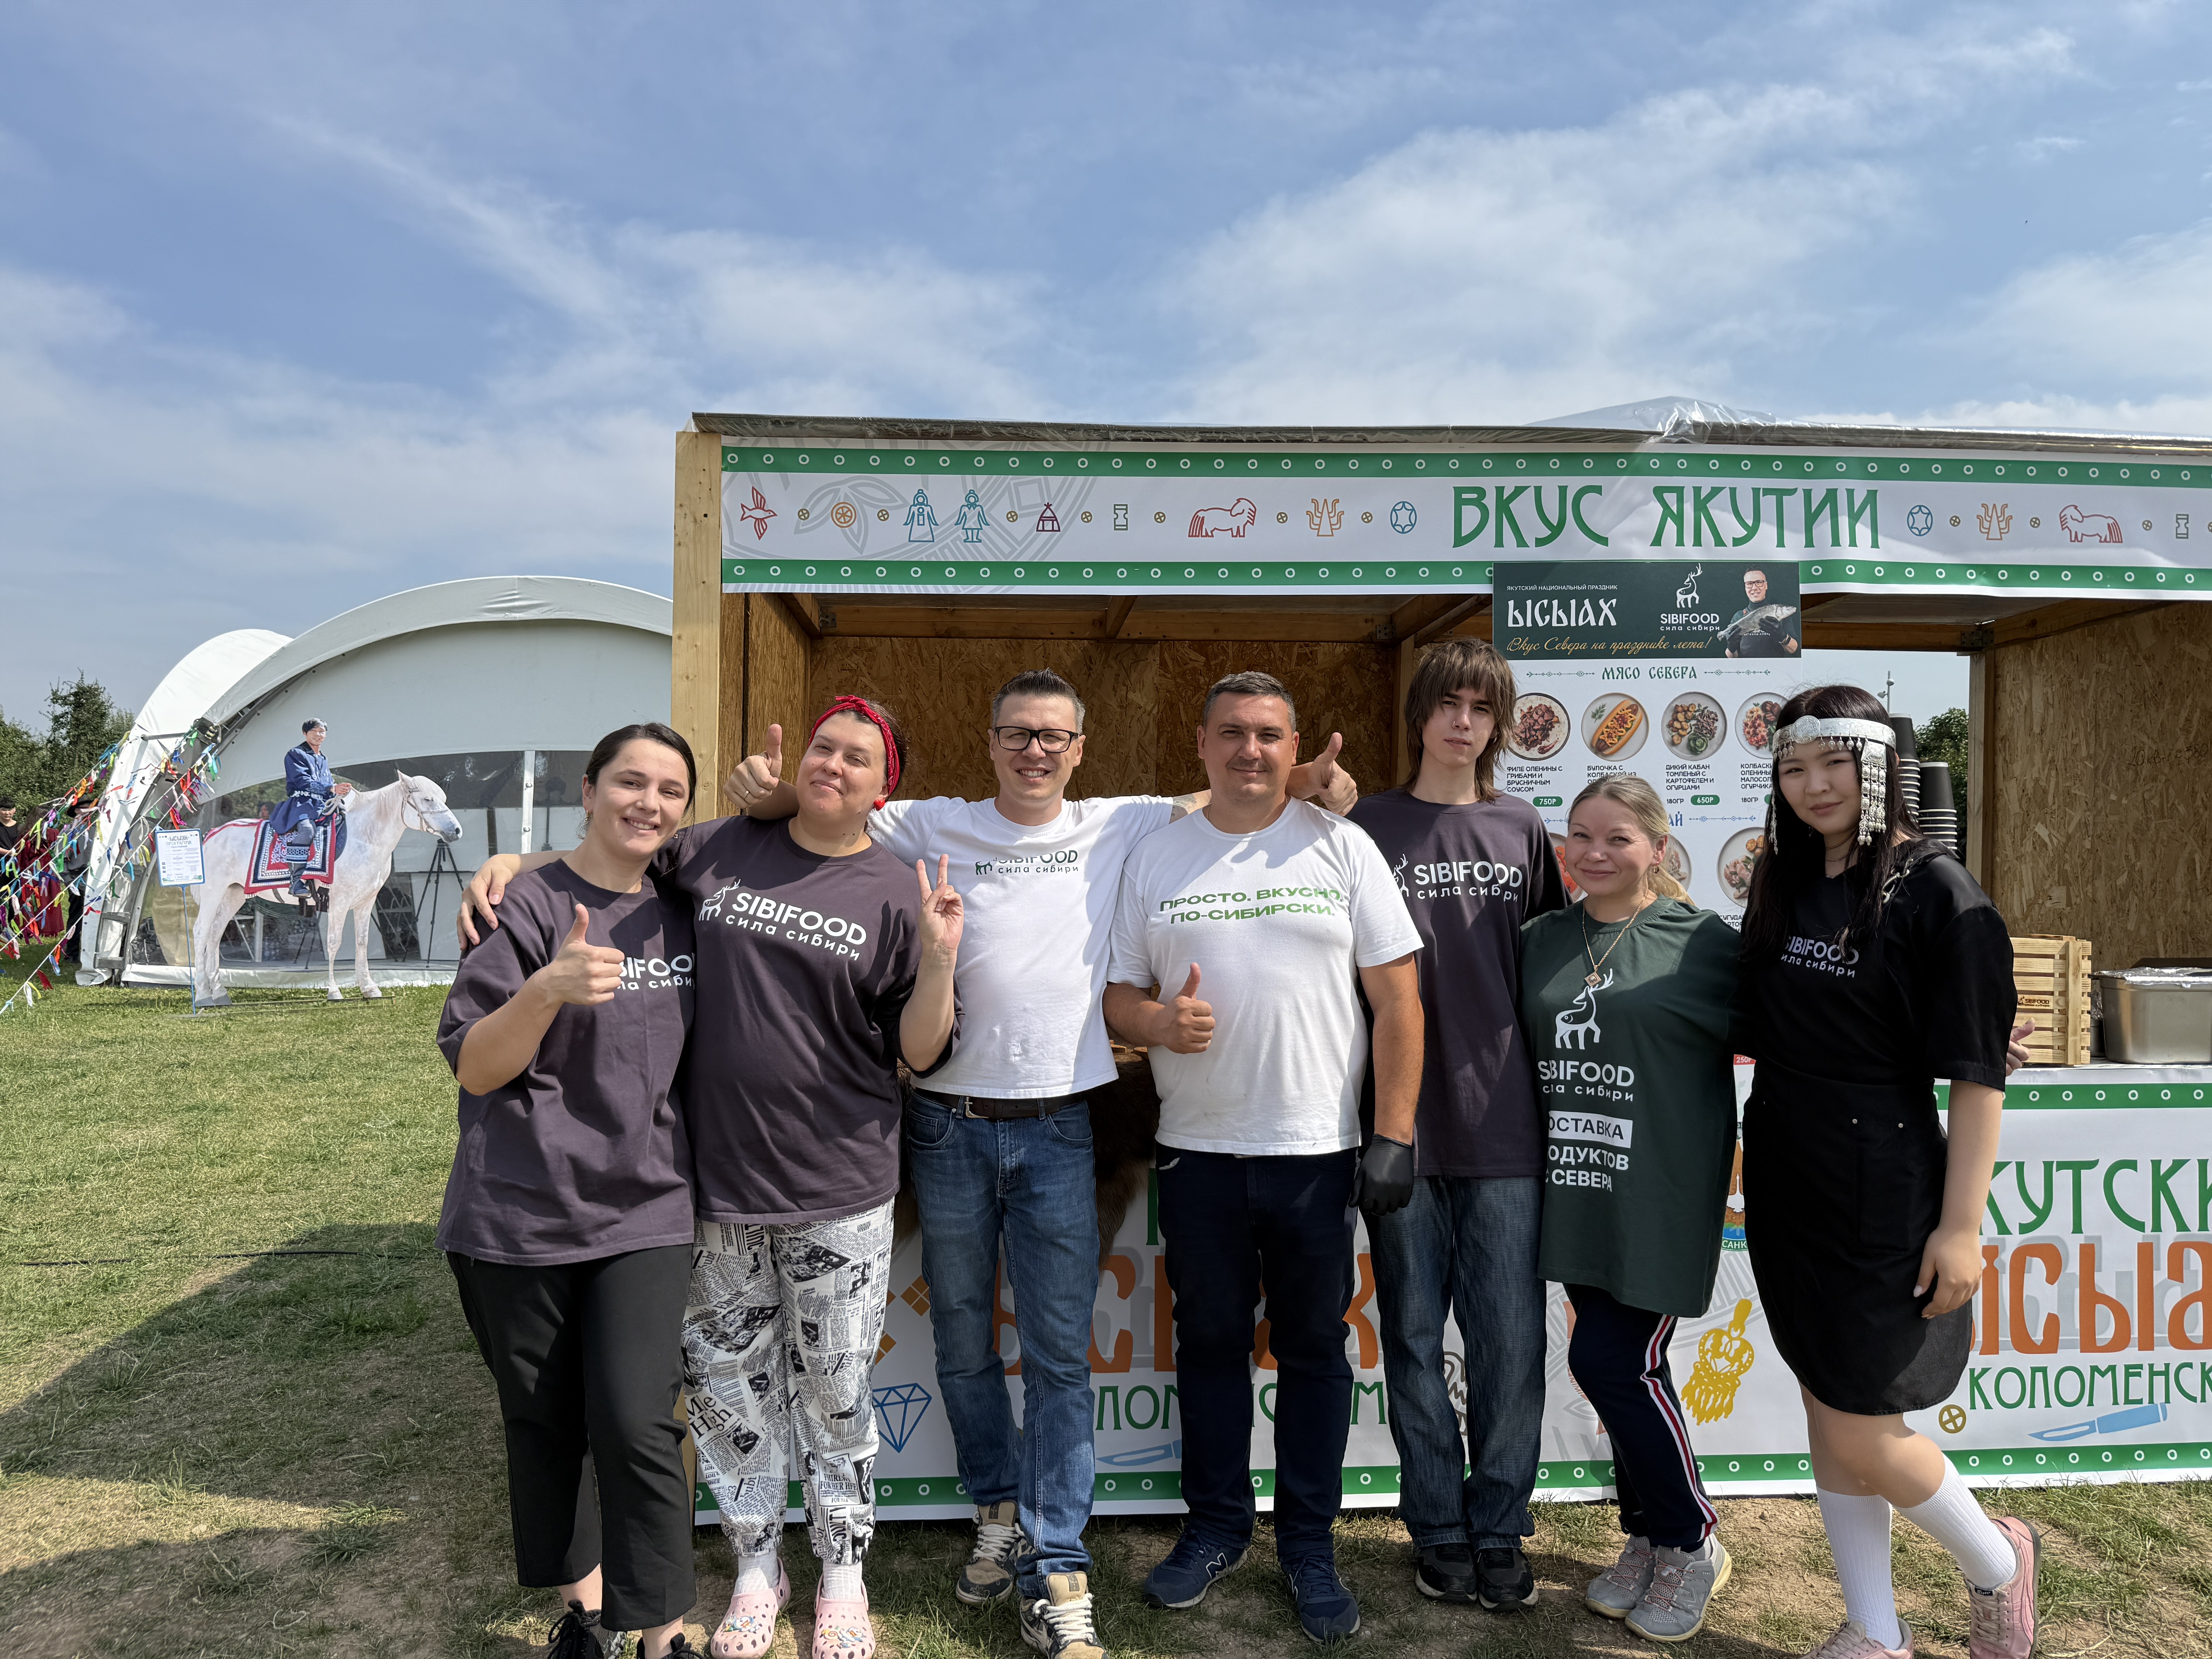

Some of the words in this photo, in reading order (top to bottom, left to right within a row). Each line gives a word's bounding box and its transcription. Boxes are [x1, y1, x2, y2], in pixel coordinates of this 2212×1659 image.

[1452, 485, 1609, 548] ВКУС
[1649, 486, 1879, 549] ЯКУТИИ
[1508, 598, 1616, 627] ЫСЫАХ
[1660, 613, 1719, 624] SIBIFOOD
[1506, 637, 1540, 655] Вкус
[1544, 637, 1588, 655] Севера
[1609, 636, 1670, 654] празднике
[1673, 637, 1712, 649] лета!
[1602, 667, 1640, 680] МЯСО
[1649, 666, 1697, 679] СЕВЕРА
[1036, 865, 1078, 873] сибири
[1414, 861, 1522, 887] SIBIFOOD
[1160, 892, 1251, 912] ПРОСТО.
[1417, 886, 1462, 899] сила
[732, 893, 867, 945] SIBIFOOD
[1170, 903, 1335, 924] ПО-СИБИРСКИ.
[725, 915, 777, 935] сила
[786, 931, 860, 960] сибири
[1781, 954, 1802, 965] ила
[1805, 960, 1855, 978] сибири
[1575, 1085, 1633, 1101] сибири
[1549, 1117, 1624, 1140] ОСТАВКА
[1548, 1145, 1629, 1170] ОДУКТОВ
[1552, 1169, 1613, 1192] СЕВЕРА
[1722, 1240, 1747, 1249] САНК
